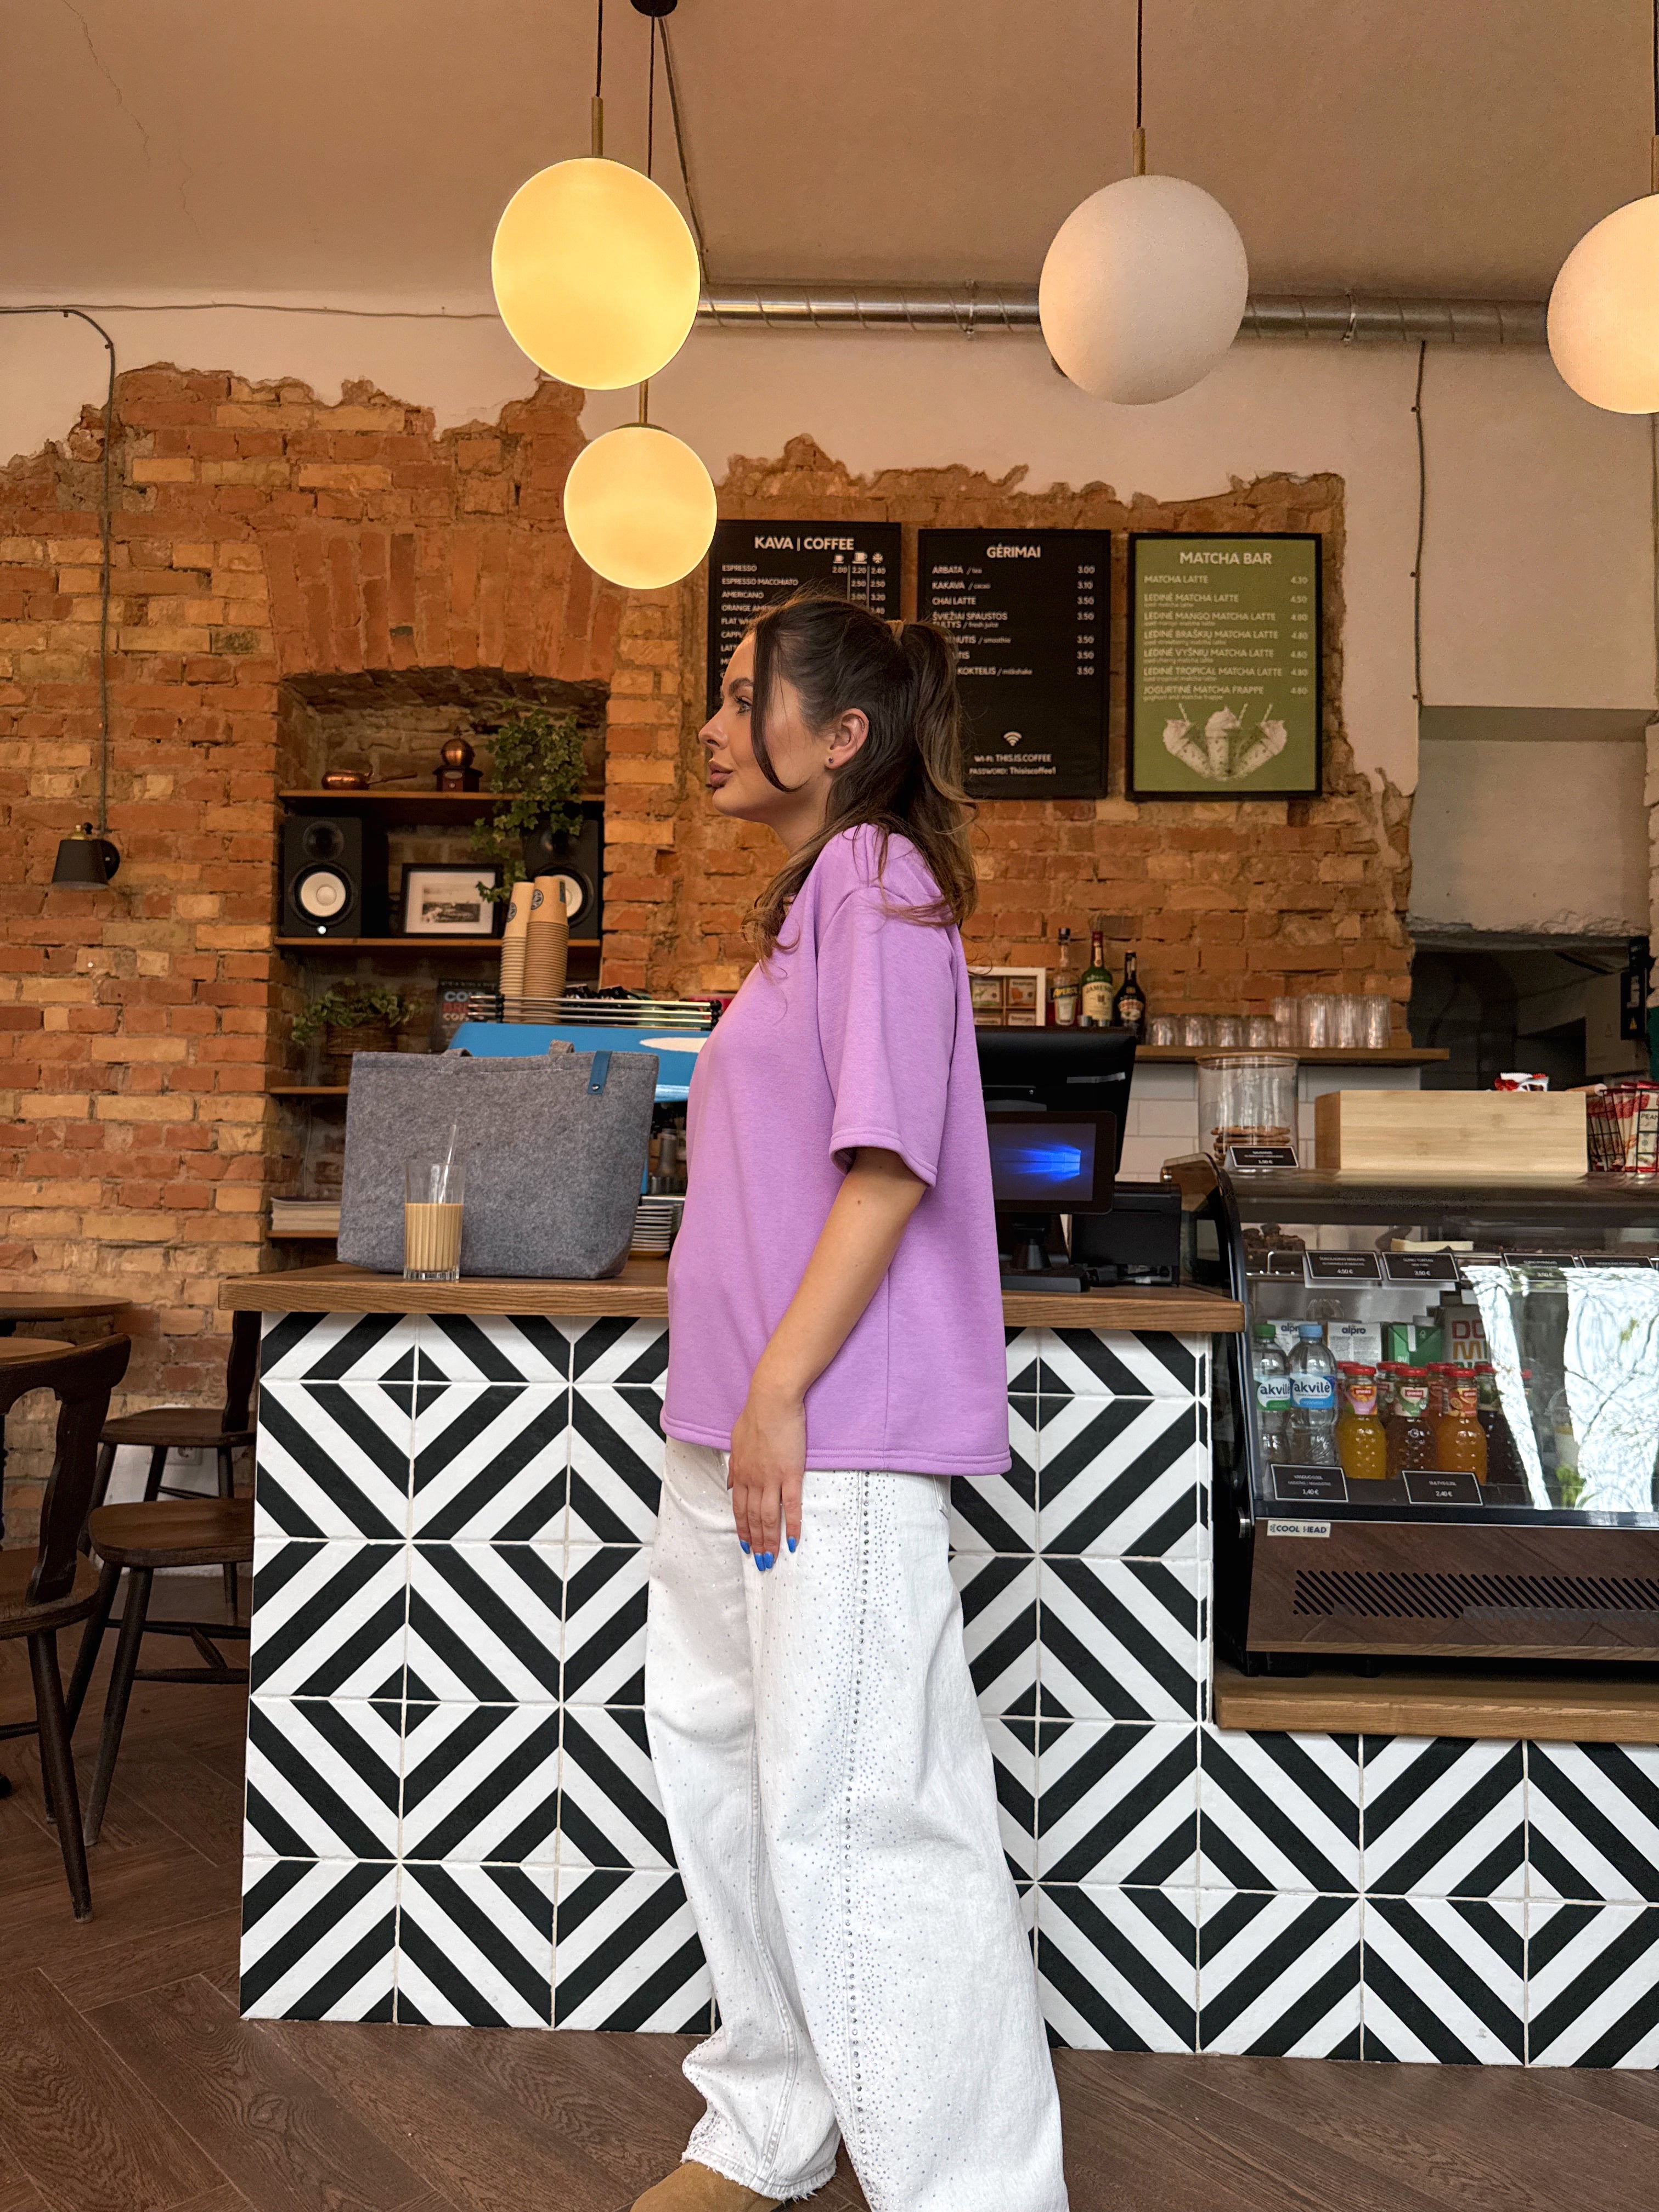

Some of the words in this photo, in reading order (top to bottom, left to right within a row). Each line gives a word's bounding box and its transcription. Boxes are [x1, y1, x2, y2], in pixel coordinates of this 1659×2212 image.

[754, 537, 793, 549] KAVA
[804, 537, 855, 550] COFFEE
[987, 542, 1041, 558] GĖRIMAI
[1180, 552, 1240, 565] MATCHA
[1243, 552, 1272, 565] BAR
[932, 565, 964, 574] ARBATA
[1077, 565, 1095, 574] 3.00
[1144, 575, 1181, 583] MATCHA
[1183, 575, 1209, 583] LATTE
[932, 581, 966, 590] KAKAVA
[932, 596, 951, 605] CHAI
[953, 596, 977, 605] LATTE
[1175, 593, 1212, 602] MATCHA
[1214, 594, 1239, 602] LATTE
[966, 612, 1008, 620] SPAUSTOS
[1175, 612, 1211, 620] MANGO
[1212, 612, 1249, 620] MATCHA
[1251, 612, 1276, 621] LATTE
[1214, 630, 1251, 639] MATCHA
[1253, 631, 1278, 639] LATTE
[1210, 648, 1247, 657] MATCHA
[1249, 649, 1274, 658] LATTE
[957, 667, 996, 675] KOKTEILIS
[1176, 667, 1216, 675] TROPICAL
[1218, 667, 1255, 676] MATCHA
[1257, 668, 1282, 676] LATTE
[1193, 686, 1231, 694] MATCHA
[1281, 1323, 1300, 1334] alpr
[1342, 1325, 1366, 1335] alpro
[1294, 1381, 1330, 1393] akvilė
